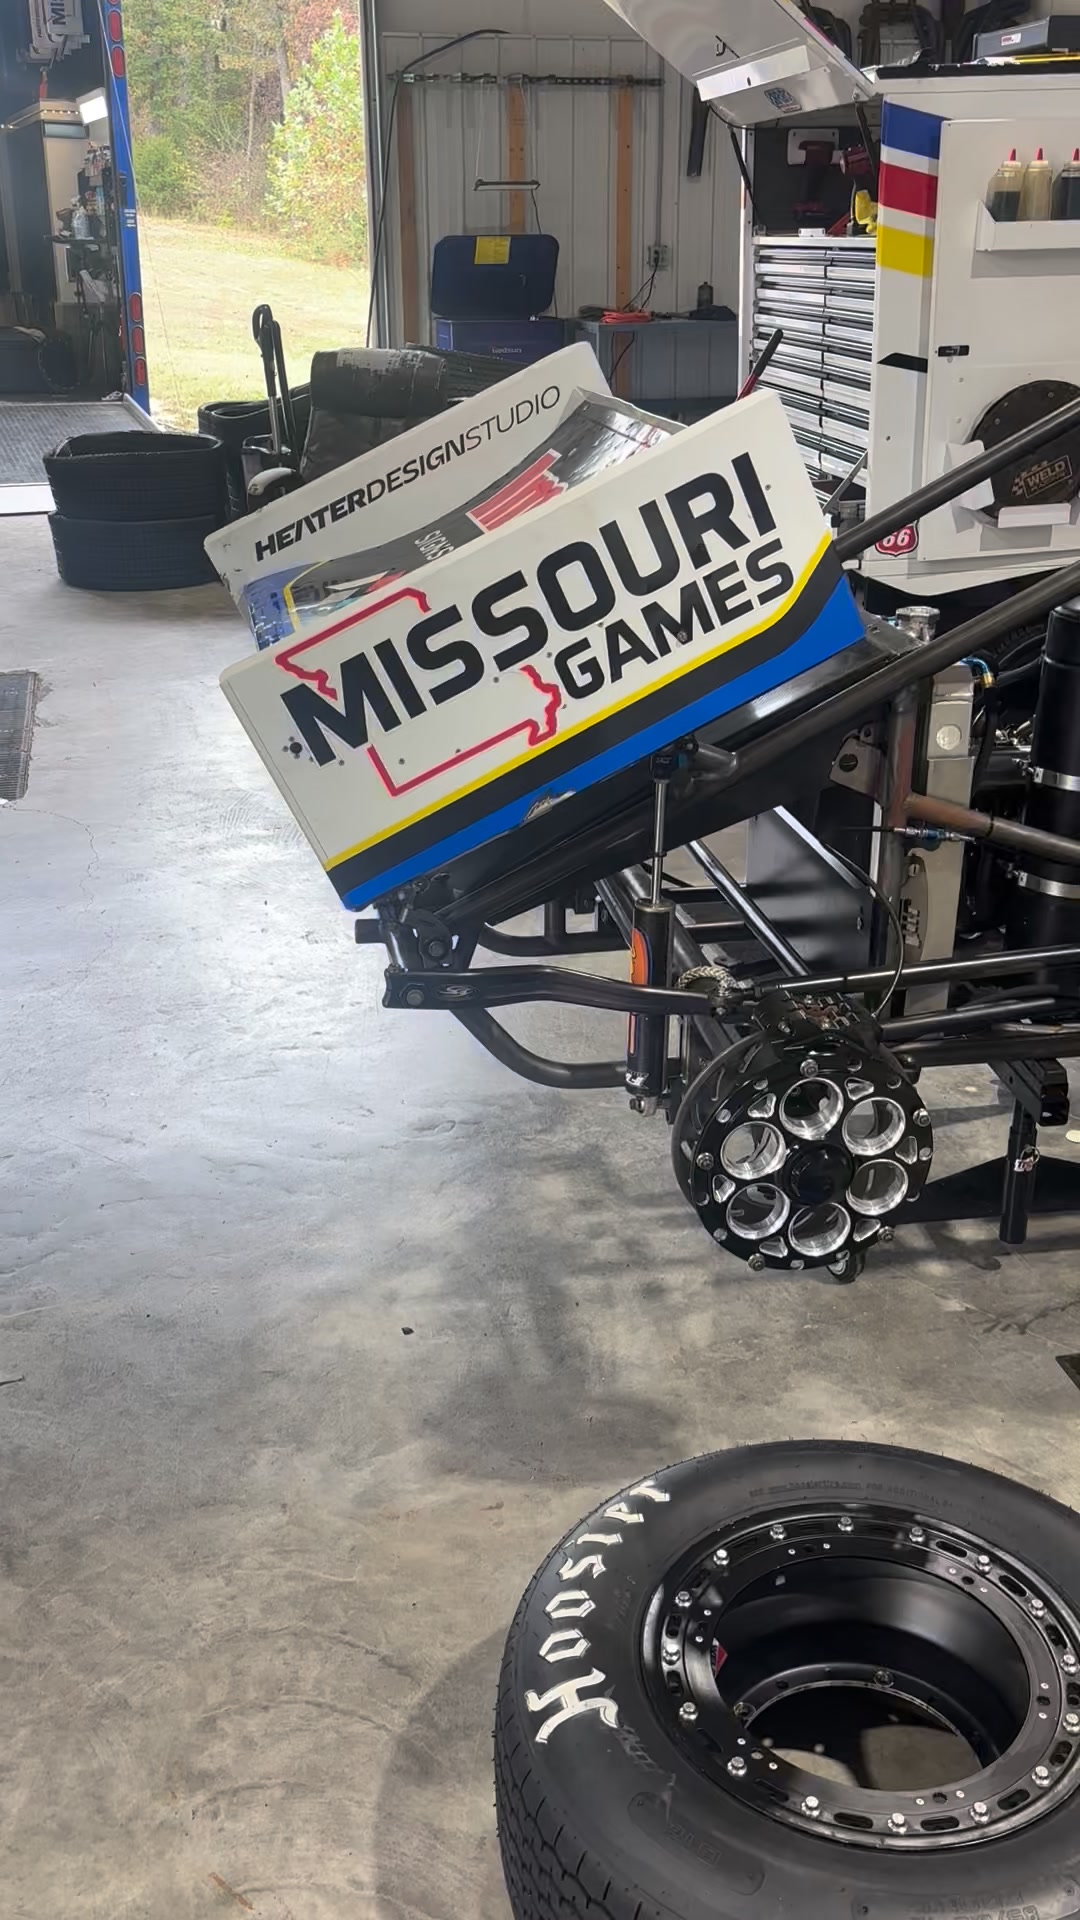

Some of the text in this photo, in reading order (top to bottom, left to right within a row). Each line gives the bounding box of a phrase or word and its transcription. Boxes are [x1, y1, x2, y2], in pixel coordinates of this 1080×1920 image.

[1027, 461, 1066, 487] WELD
[882, 528, 911, 547] 66
[280, 452, 776, 767] MISSOURI
[555, 540, 794, 700] GAMES
